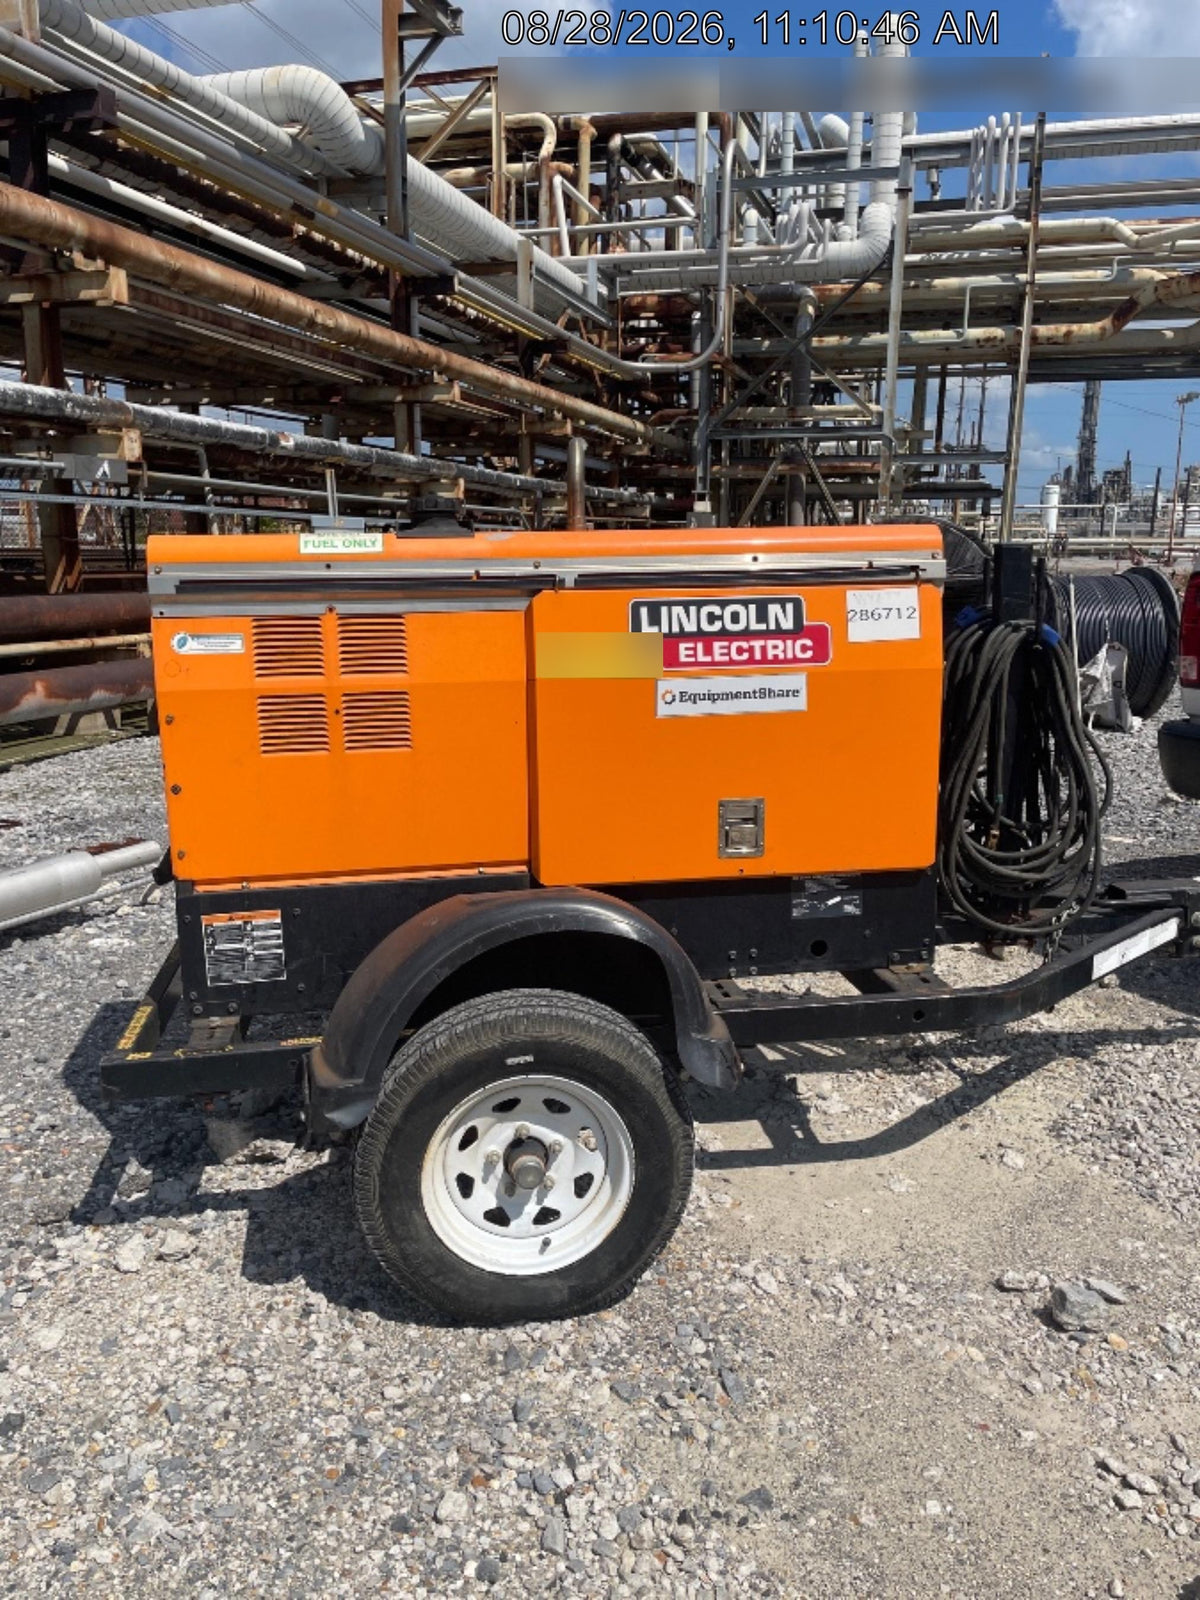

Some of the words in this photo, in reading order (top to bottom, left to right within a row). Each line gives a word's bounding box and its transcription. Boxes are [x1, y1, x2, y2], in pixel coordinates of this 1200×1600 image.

[303, 538, 338, 549] FUEL
[342, 538, 378, 549] ONLY
[639, 601, 795, 634] LINCOLN
[847, 605, 918, 623] 286712
[678, 638, 814, 664] ELECTRIC
[678, 687, 801, 705] EquipmentShare
